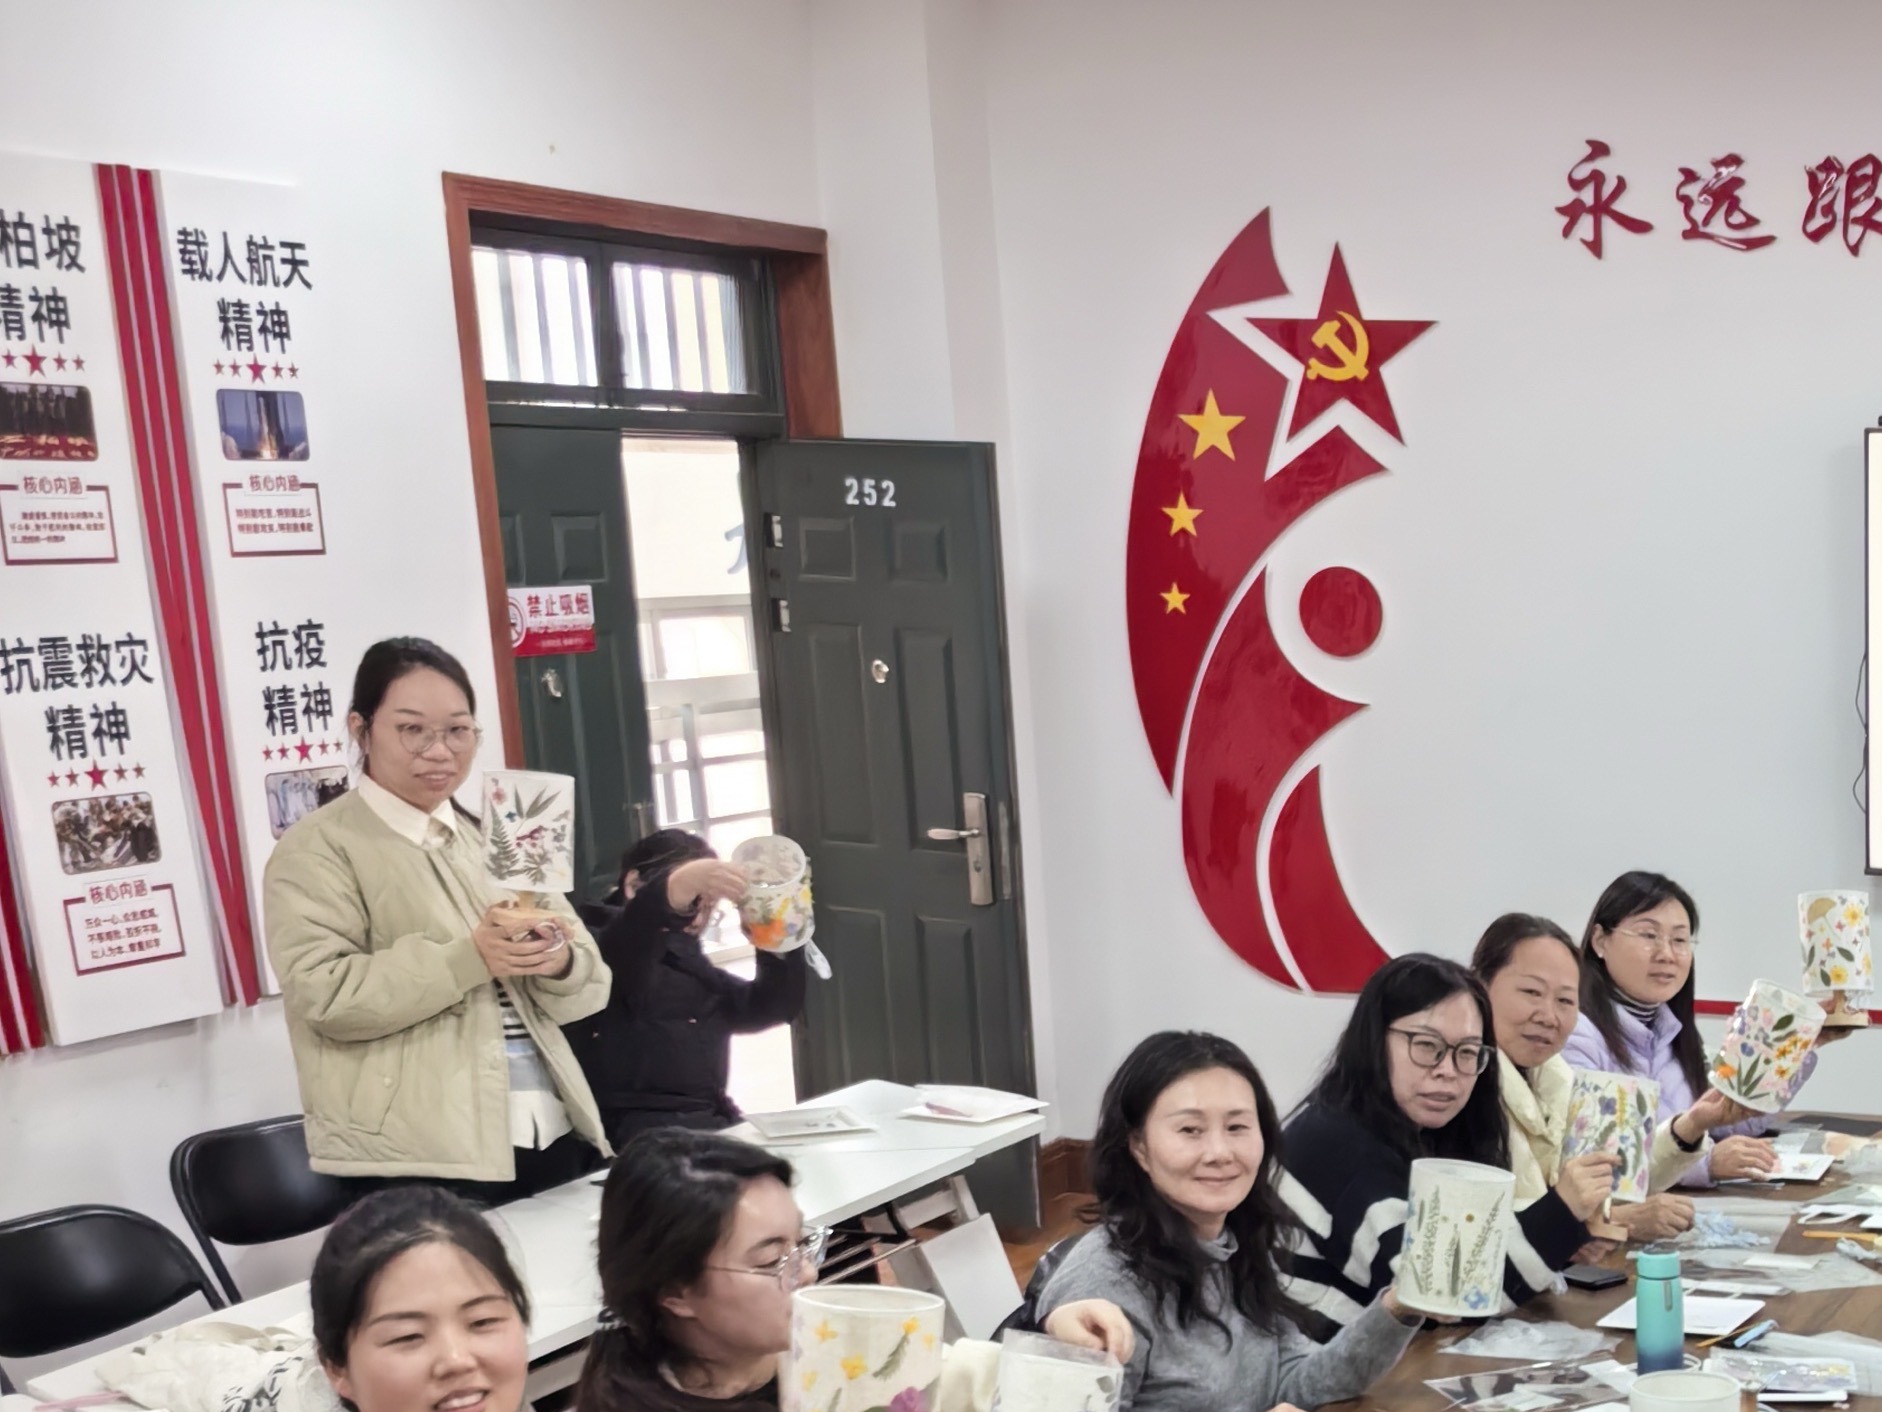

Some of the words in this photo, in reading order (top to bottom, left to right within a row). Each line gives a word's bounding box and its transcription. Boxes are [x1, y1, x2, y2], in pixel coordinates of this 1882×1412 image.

[177, 228, 313, 290] 载人航天
[217, 298, 292, 354] 精神
[844, 477, 897, 507] 252
[0, 632, 154, 695] 抗震救灾
[255, 618, 328, 673] 抗疫
[45, 701, 132, 761] 精神
[262, 681, 334, 737] 精神
